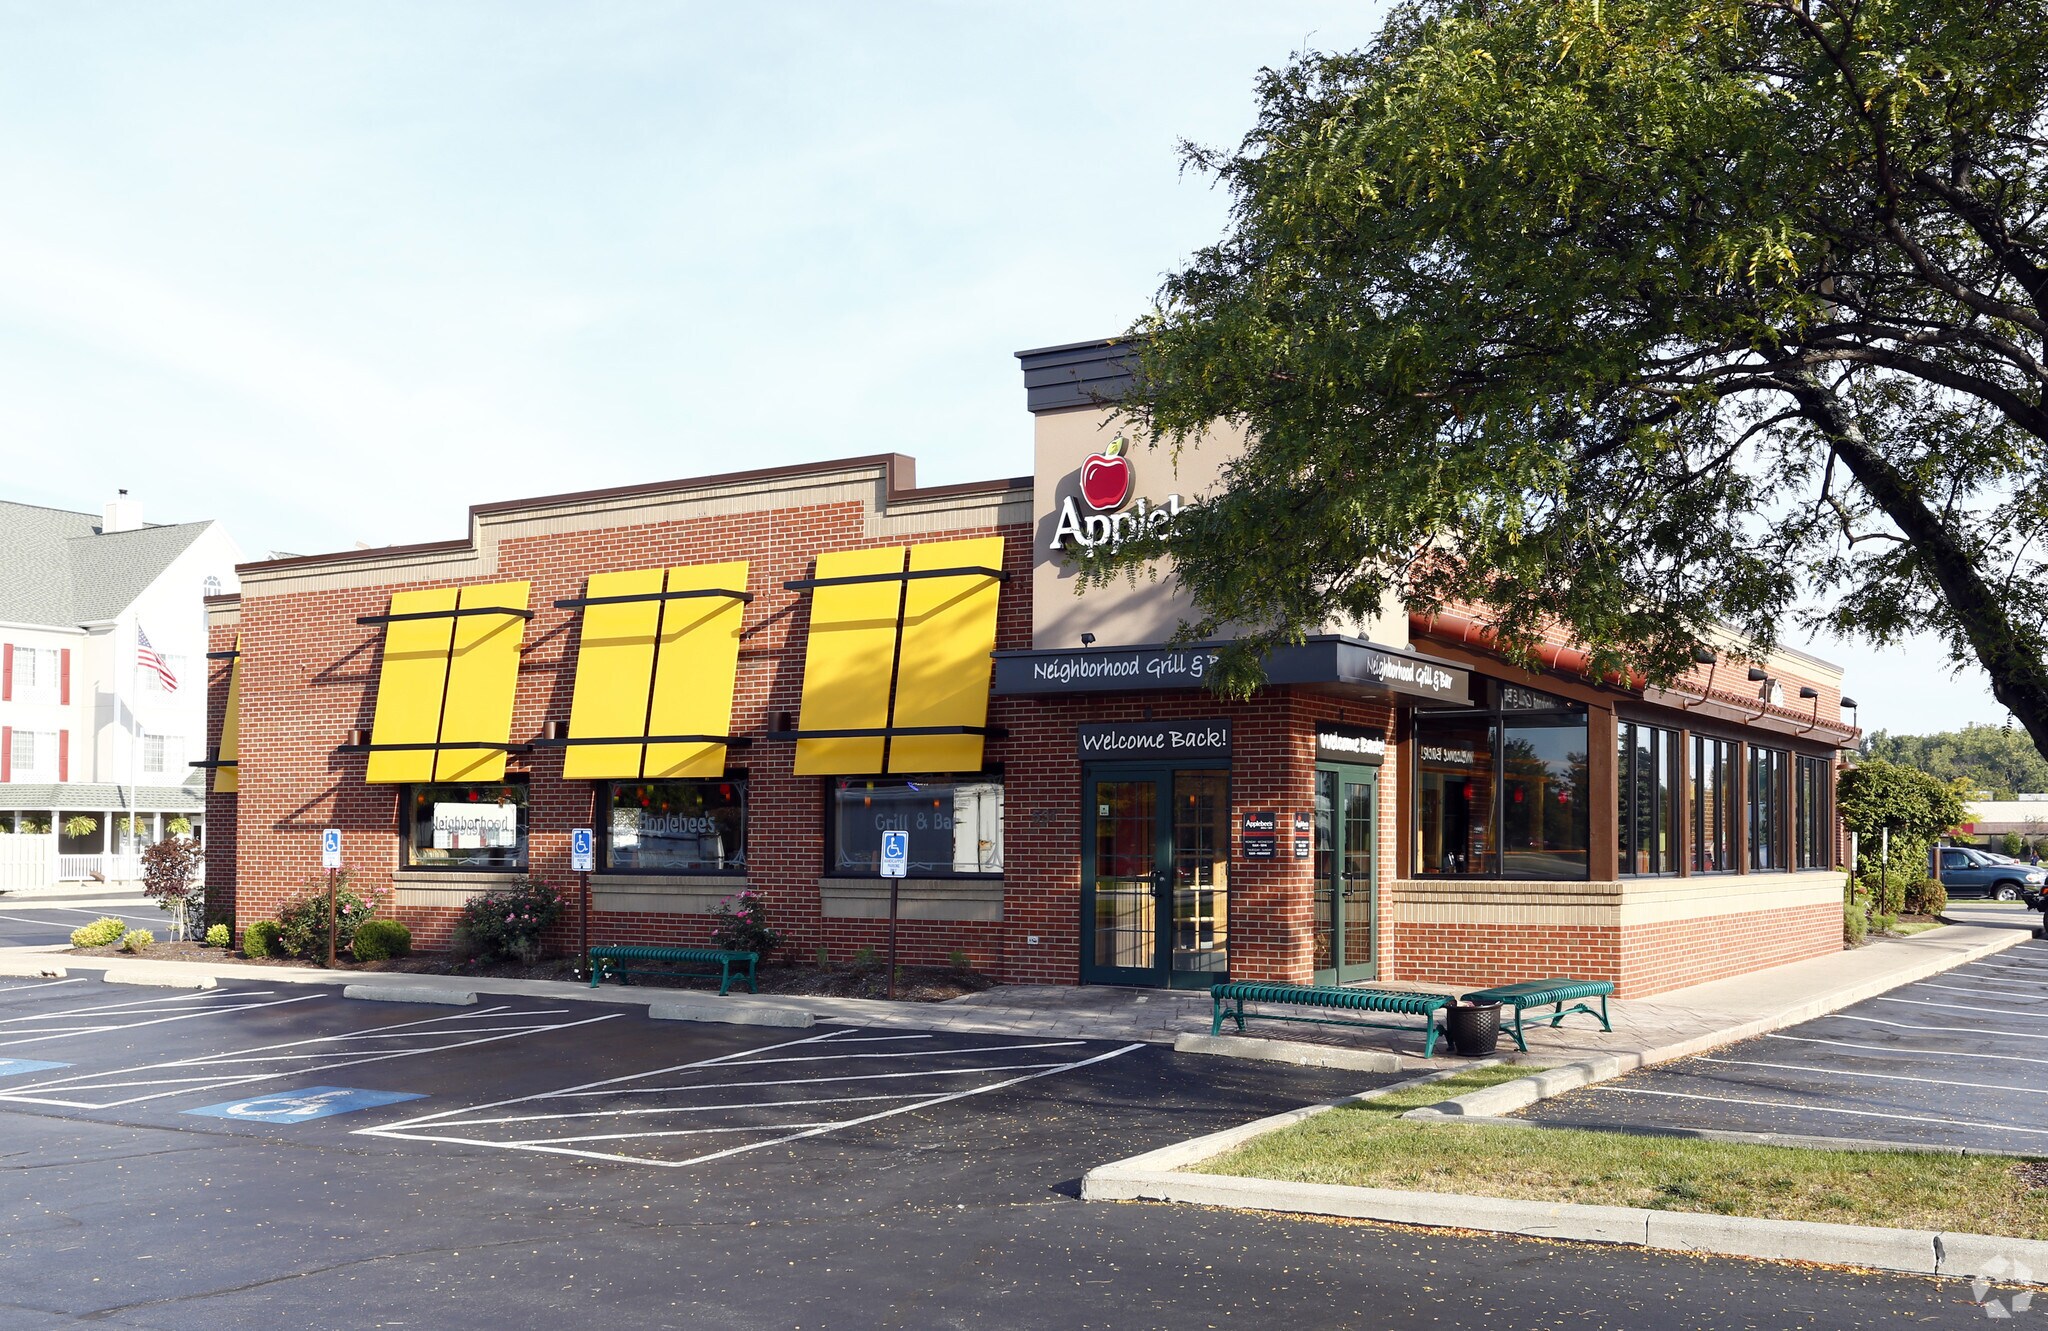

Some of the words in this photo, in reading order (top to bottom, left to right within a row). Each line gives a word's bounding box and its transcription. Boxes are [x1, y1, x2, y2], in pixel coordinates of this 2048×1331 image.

[1034, 655, 1140, 684] Neighborhood
[1146, 653, 1186, 679] Grill
[1190, 655, 1203, 678] &
[1366, 655, 1415, 682] Neighborhood
[1415, 665, 1433, 688] Grill
[1433, 670, 1440, 692] &
[1439, 670, 1453, 689] Bar
[1082, 731, 1165, 751] Welcome
[1168, 727, 1227, 748] Back!
[1319, 731, 1360, 753] Welcome
[1360, 736, 1385, 756] Back!
[874, 813, 909, 831] Grill
[916, 811, 928, 830] &
